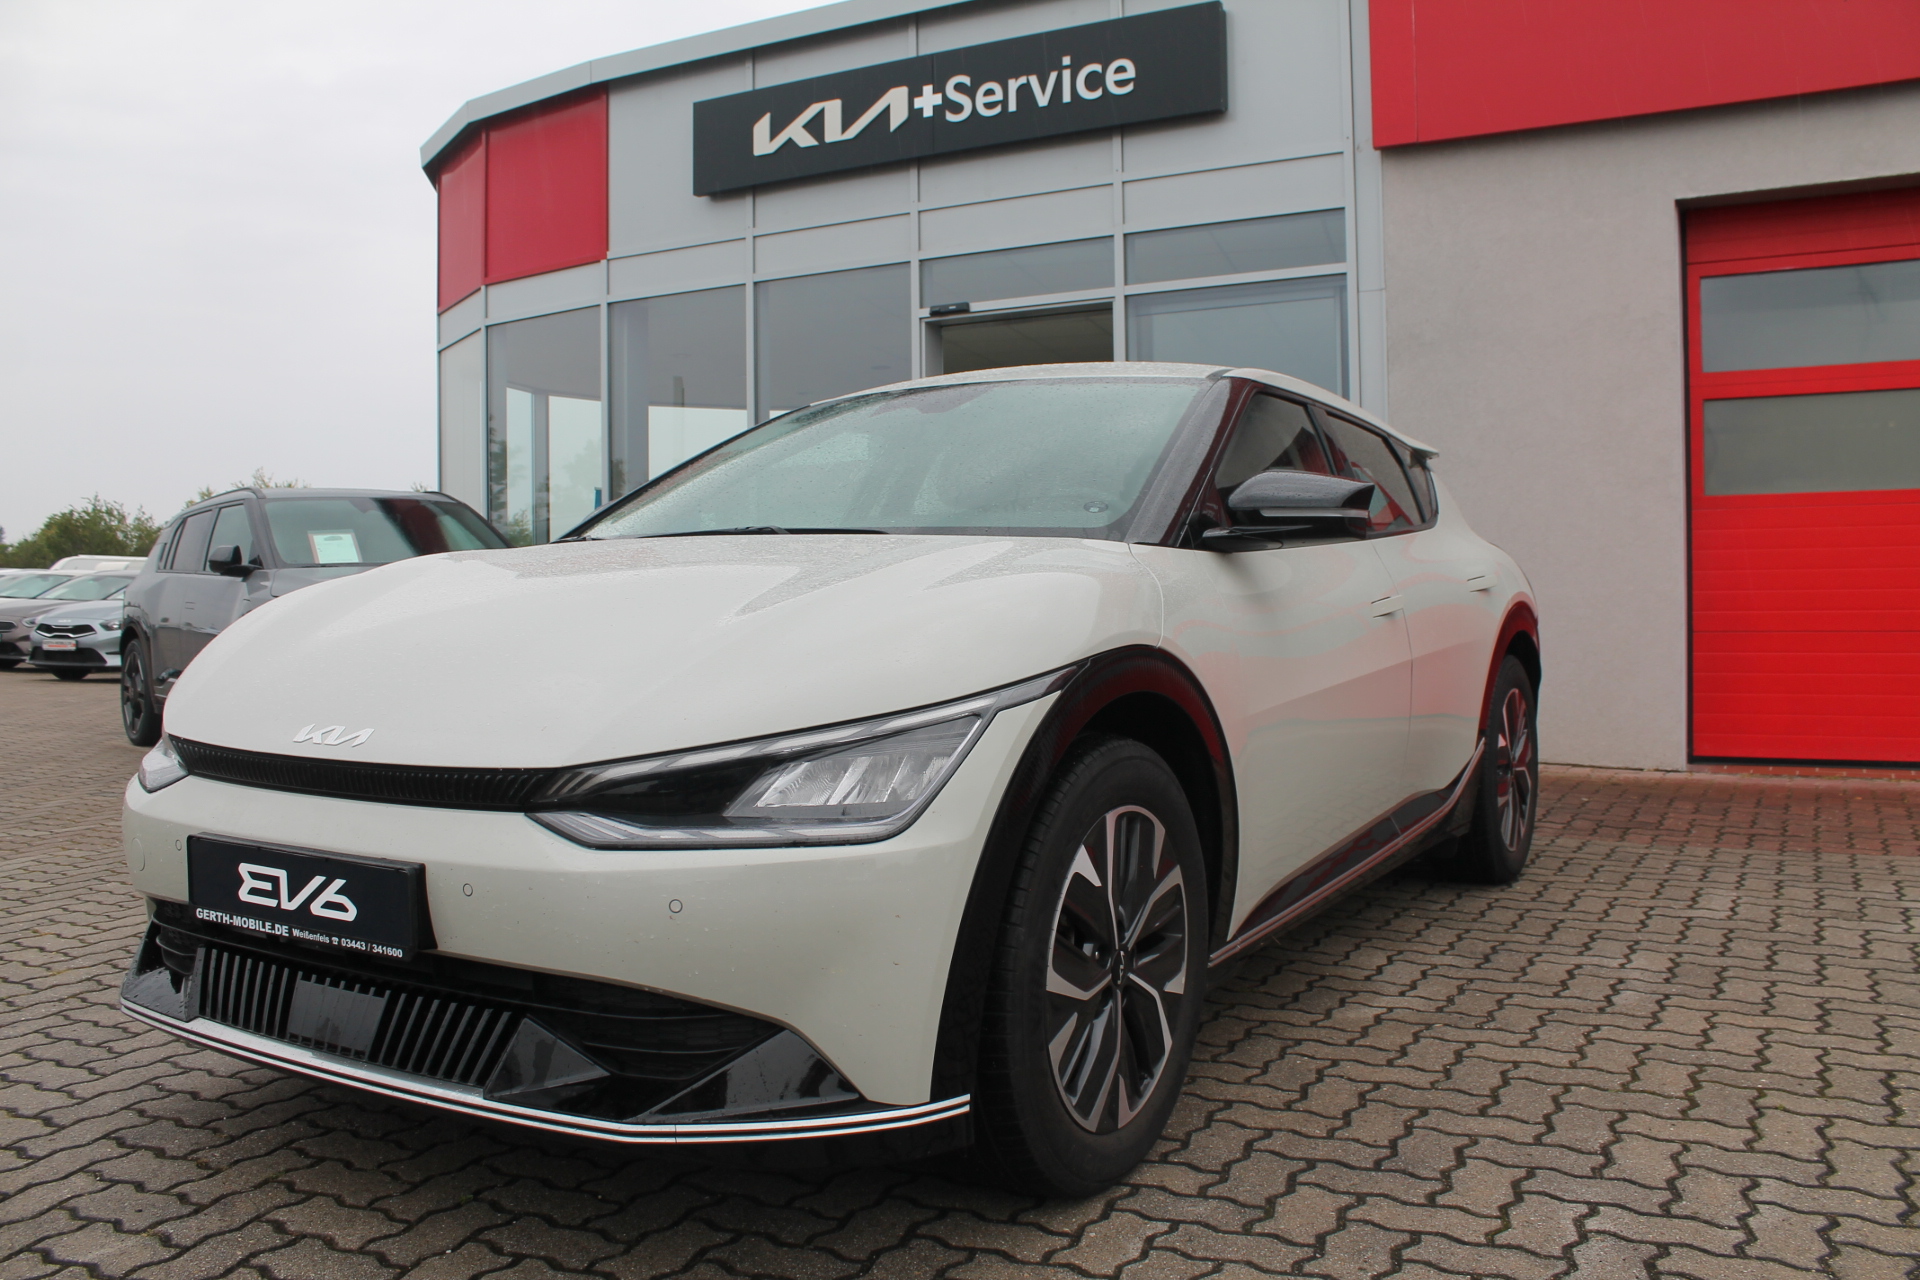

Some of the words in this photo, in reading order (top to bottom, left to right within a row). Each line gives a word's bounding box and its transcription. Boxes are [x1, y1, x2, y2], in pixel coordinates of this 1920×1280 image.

[753, 86, 909, 156] KIA
[292, 723, 375, 748] KIA
[238, 862, 357, 922] EV6
[196, 908, 289, 937] GERTH-MOBILE.DE
[292, 928, 330, 944] Weißenfels
[341, 938, 366, 950] 03443
[372, 944, 403, 958] 341600
